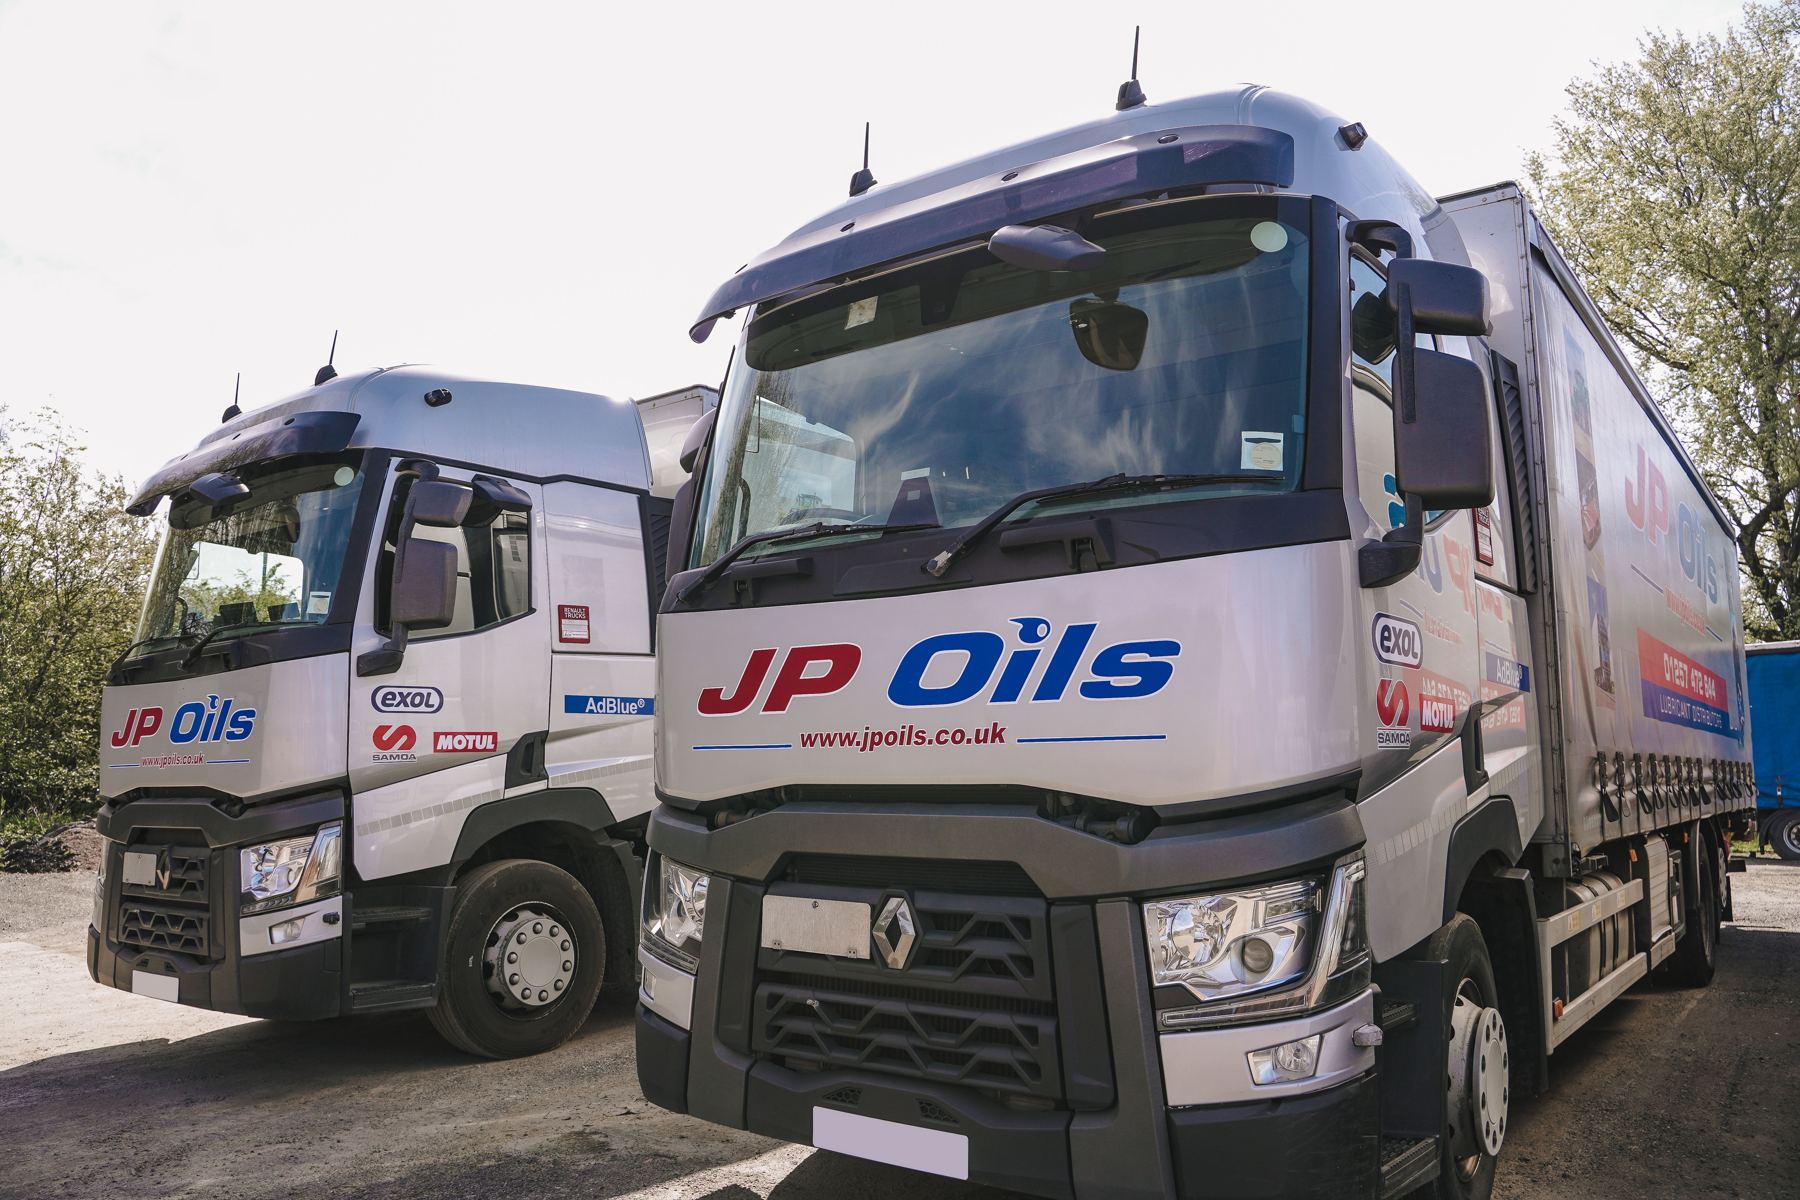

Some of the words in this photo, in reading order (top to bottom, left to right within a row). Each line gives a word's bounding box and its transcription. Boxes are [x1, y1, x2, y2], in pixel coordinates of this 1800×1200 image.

[1625, 443, 1669, 545] JP
[1678, 501, 1718, 604] Oils
[697, 642, 862, 717] JP
[887, 616, 1182, 708] Oils
[1663, 652, 1689, 689] 01257
[111, 706, 164, 749] JP
[169, 694, 257, 745] Oils
[1422, 700, 1455, 729] MOTUL
[437, 734, 496, 751] MOTUL
[800, 721, 1007, 753] www.jpoils.co.uk
[1378, 732, 1411, 745] SAMOA
[142, 753, 204, 769] www.jpoils.co.uk
[372, 753, 417, 761] SAMOA
